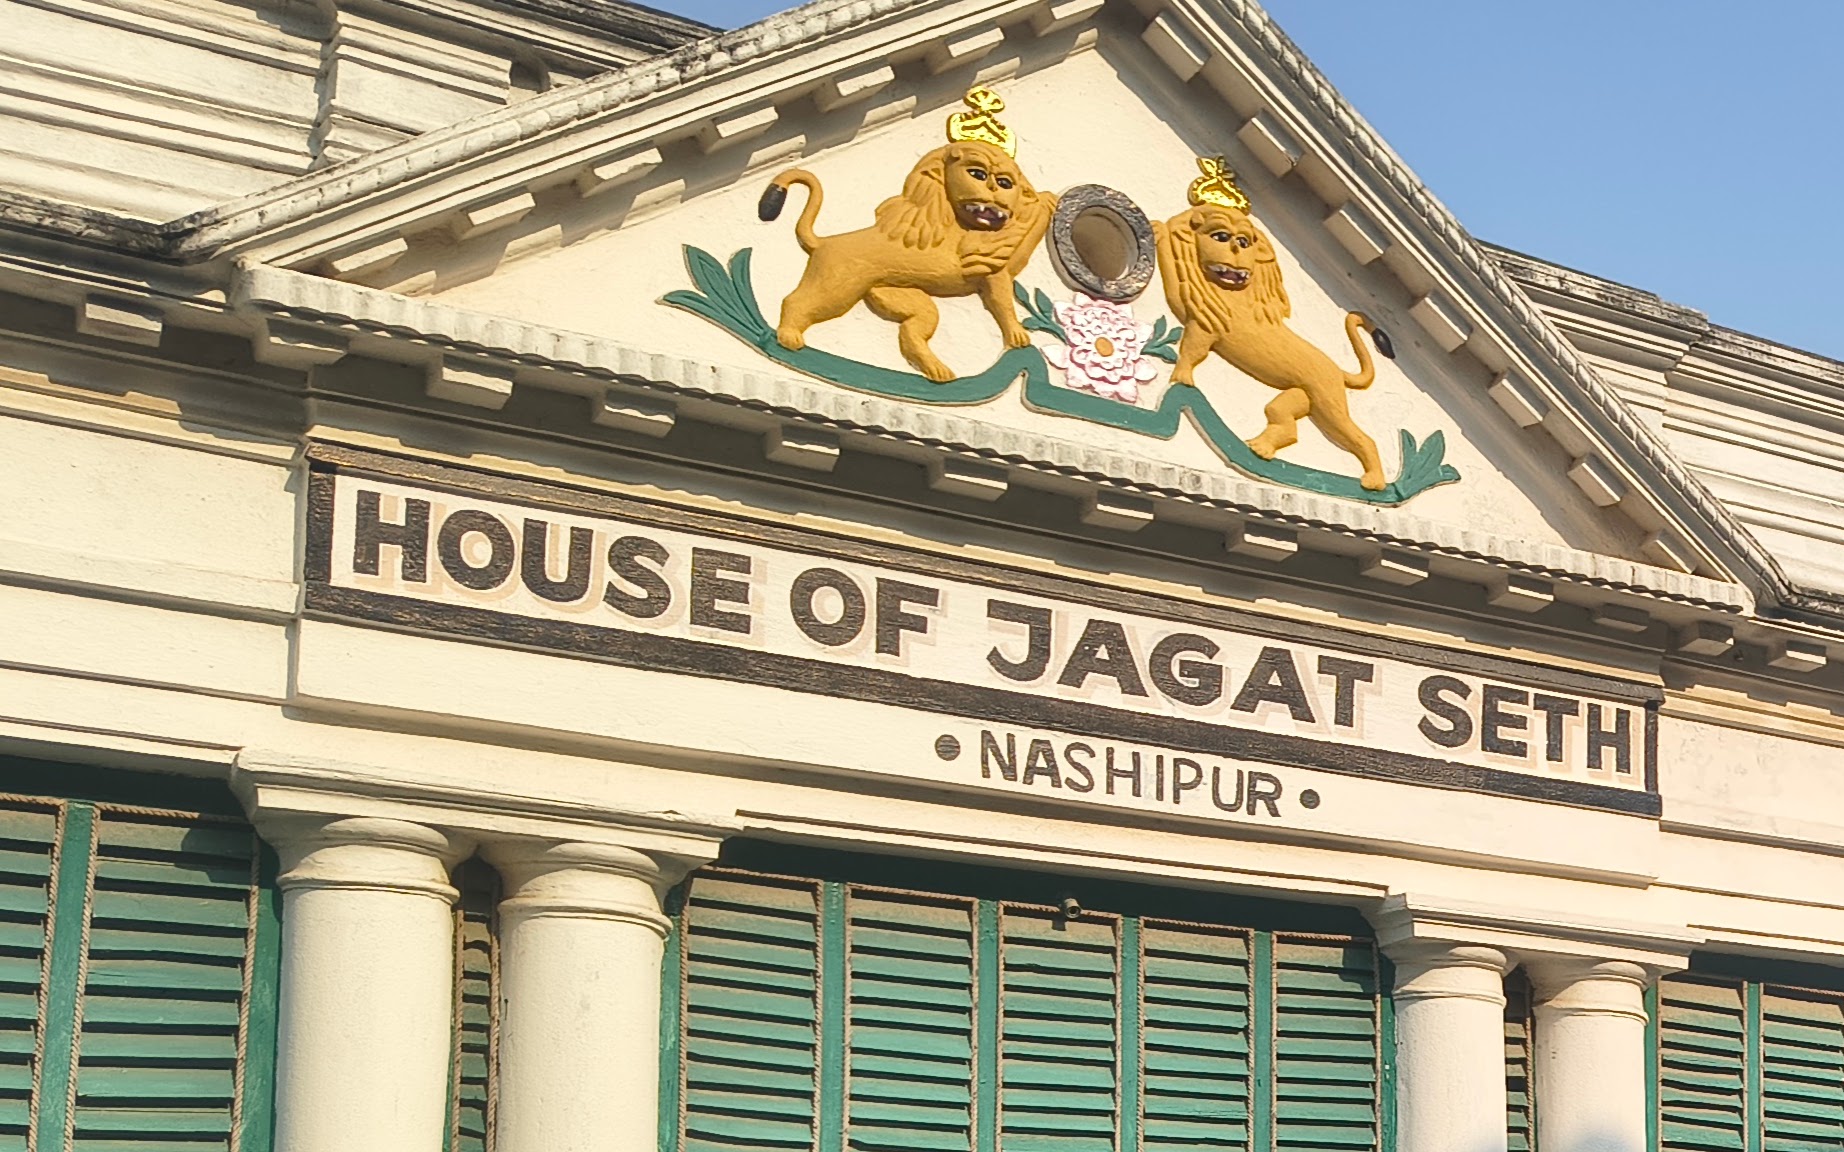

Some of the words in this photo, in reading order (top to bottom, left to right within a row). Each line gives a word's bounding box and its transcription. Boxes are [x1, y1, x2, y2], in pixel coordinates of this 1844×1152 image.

[353, 489, 752, 635] HOUSE
[790, 567, 939, 657] OF
[986, 598, 1374, 727] JAGAT
[1417, 674, 1631, 774] SETH
[981, 729, 1283, 818] NASHIPUR
